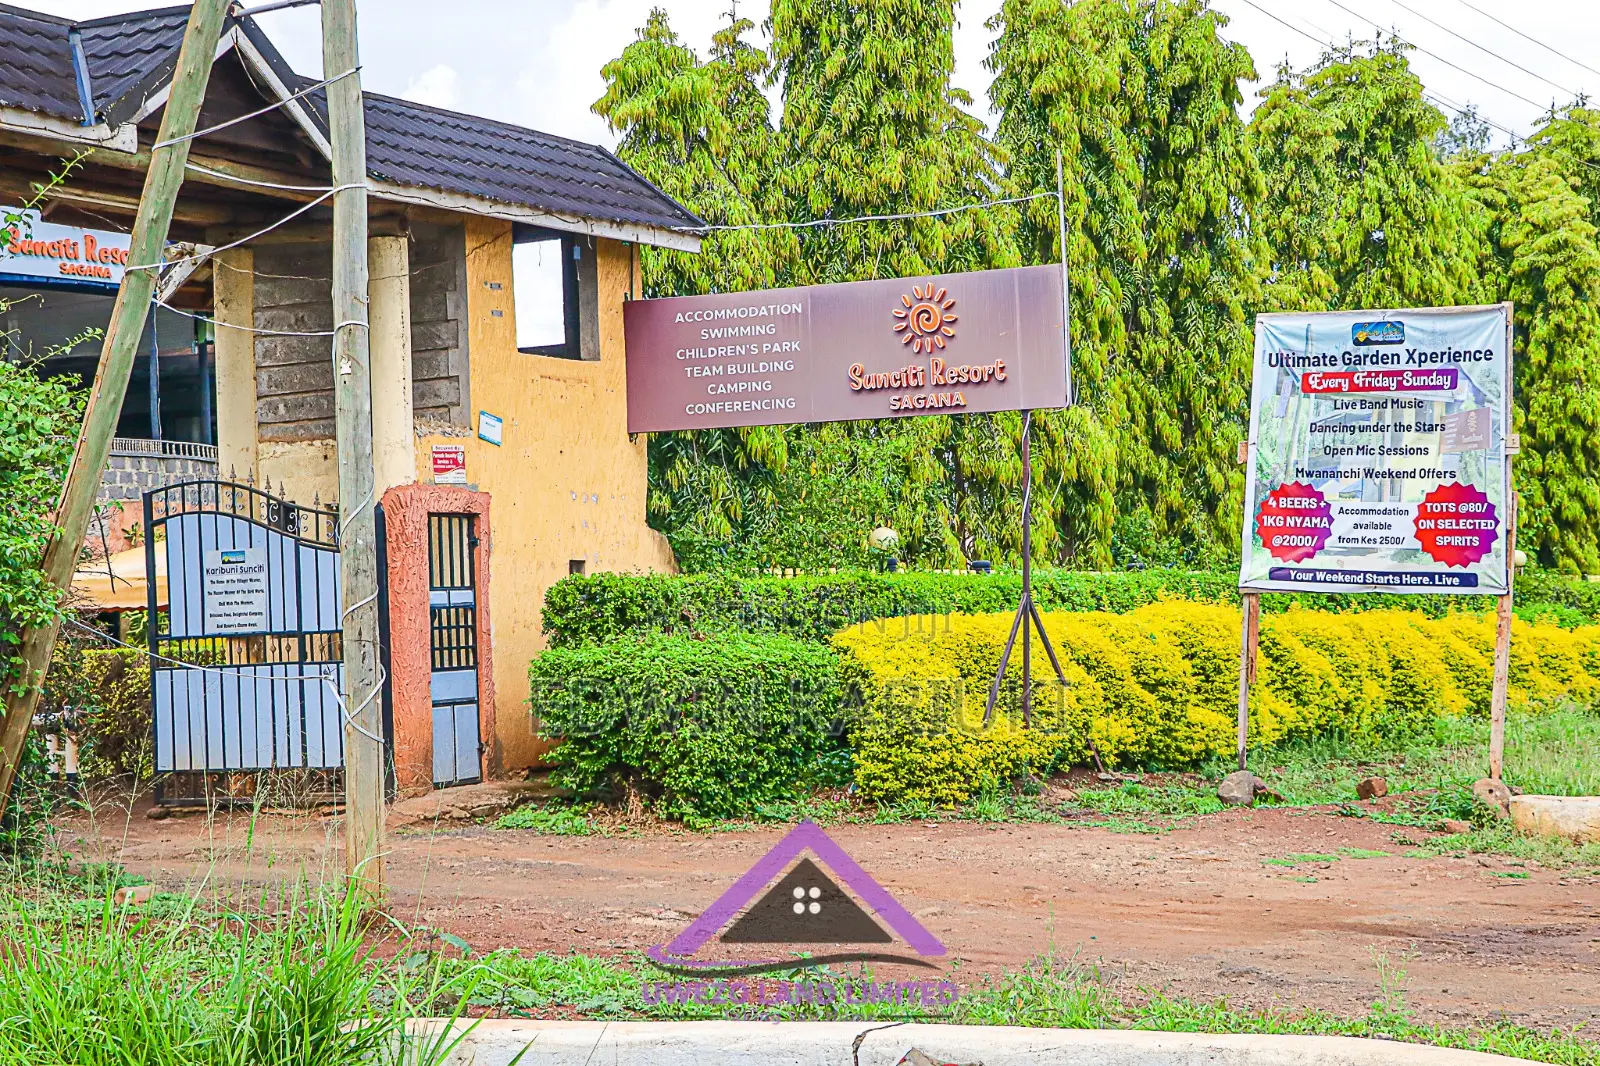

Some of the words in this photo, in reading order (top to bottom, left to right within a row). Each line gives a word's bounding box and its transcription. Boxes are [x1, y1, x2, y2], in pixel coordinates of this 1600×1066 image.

[8, 227, 79, 260] Sunciti
[84, 235, 129, 265] Reso
[59, 263, 112, 278] SAGANA
[675, 303, 802, 324] ACCOMMODATION
[701, 324, 776, 340] SWIMMING
[676, 344, 759, 360] CHILDREN'S
[763, 341, 800, 354] PARK
[1269, 353, 1338, 368] Ultimate
[1341, 350, 1401, 365] Garden
[1406, 347, 1493, 365] Xperience
[685, 365, 725, 378] TEAM
[727, 360, 794, 375] BUILDING
[848, 363, 925, 391] Sunciti
[930, 357, 1007, 385] Resort
[707, 381, 772, 394] CAMPING
[1308, 372, 1349, 390] Every
[685, 398, 796, 415] CONFERENCING
[890, 392, 966, 410] SAGANA
[1334, 400, 1357, 410] Live
[1360, 399, 1387, 410] Band
[1391, 399, 1424, 409] Music
[1309, 422, 1356, 435] Dancing
[1359, 422, 1390, 432] under
[1394, 422, 1412, 432] the
[1415, 421, 1445, 432] Stars
[1324, 445, 1353, 458] Open
[1356, 445, 1376, 456] Mic
[1379, 445, 1429, 456] Sessions
[1295, 468, 1360, 479] Mwananchi
[1363, 467, 1415, 479] Weekend
[1419, 468, 1456, 479] Offers
[1268, 498, 1276, 508] 4
[1279, 498, 1317, 508] BEERS
[1426, 503, 1456, 513] TOTS
[1458, 503, 1487, 513] @80/
[1338, 507, 1409, 517] Accommodation
[1262, 516, 1284, 527] 1KG
[1286, 515, 1329, 528] NYAMA
[1353, 522, 1392, 530] available
[1418, 520, 1435, 529] ON
[1437, 519, 1495, 529] SELECTED
[1272, 535, 1318, 547] @2000/
[1338, 536, 1359, 544] from
[1361, 536, 1377, 545] Kes
[1379, 536, 1405, 545] 2500/
[1436, 536, 1479, 546] SPIRITS
[206, 566, 238, 575] Karibuni
[240, 564, 264, 573] Sunciti
[1289, 570, 1314, 580] Your
[1316, 572, 1363, 583] Weekend
[1365, 573, 1400, 584] Starts
[1402, 575, 1432, 585] Here.
[1435, 575, 1460, 585] Live
